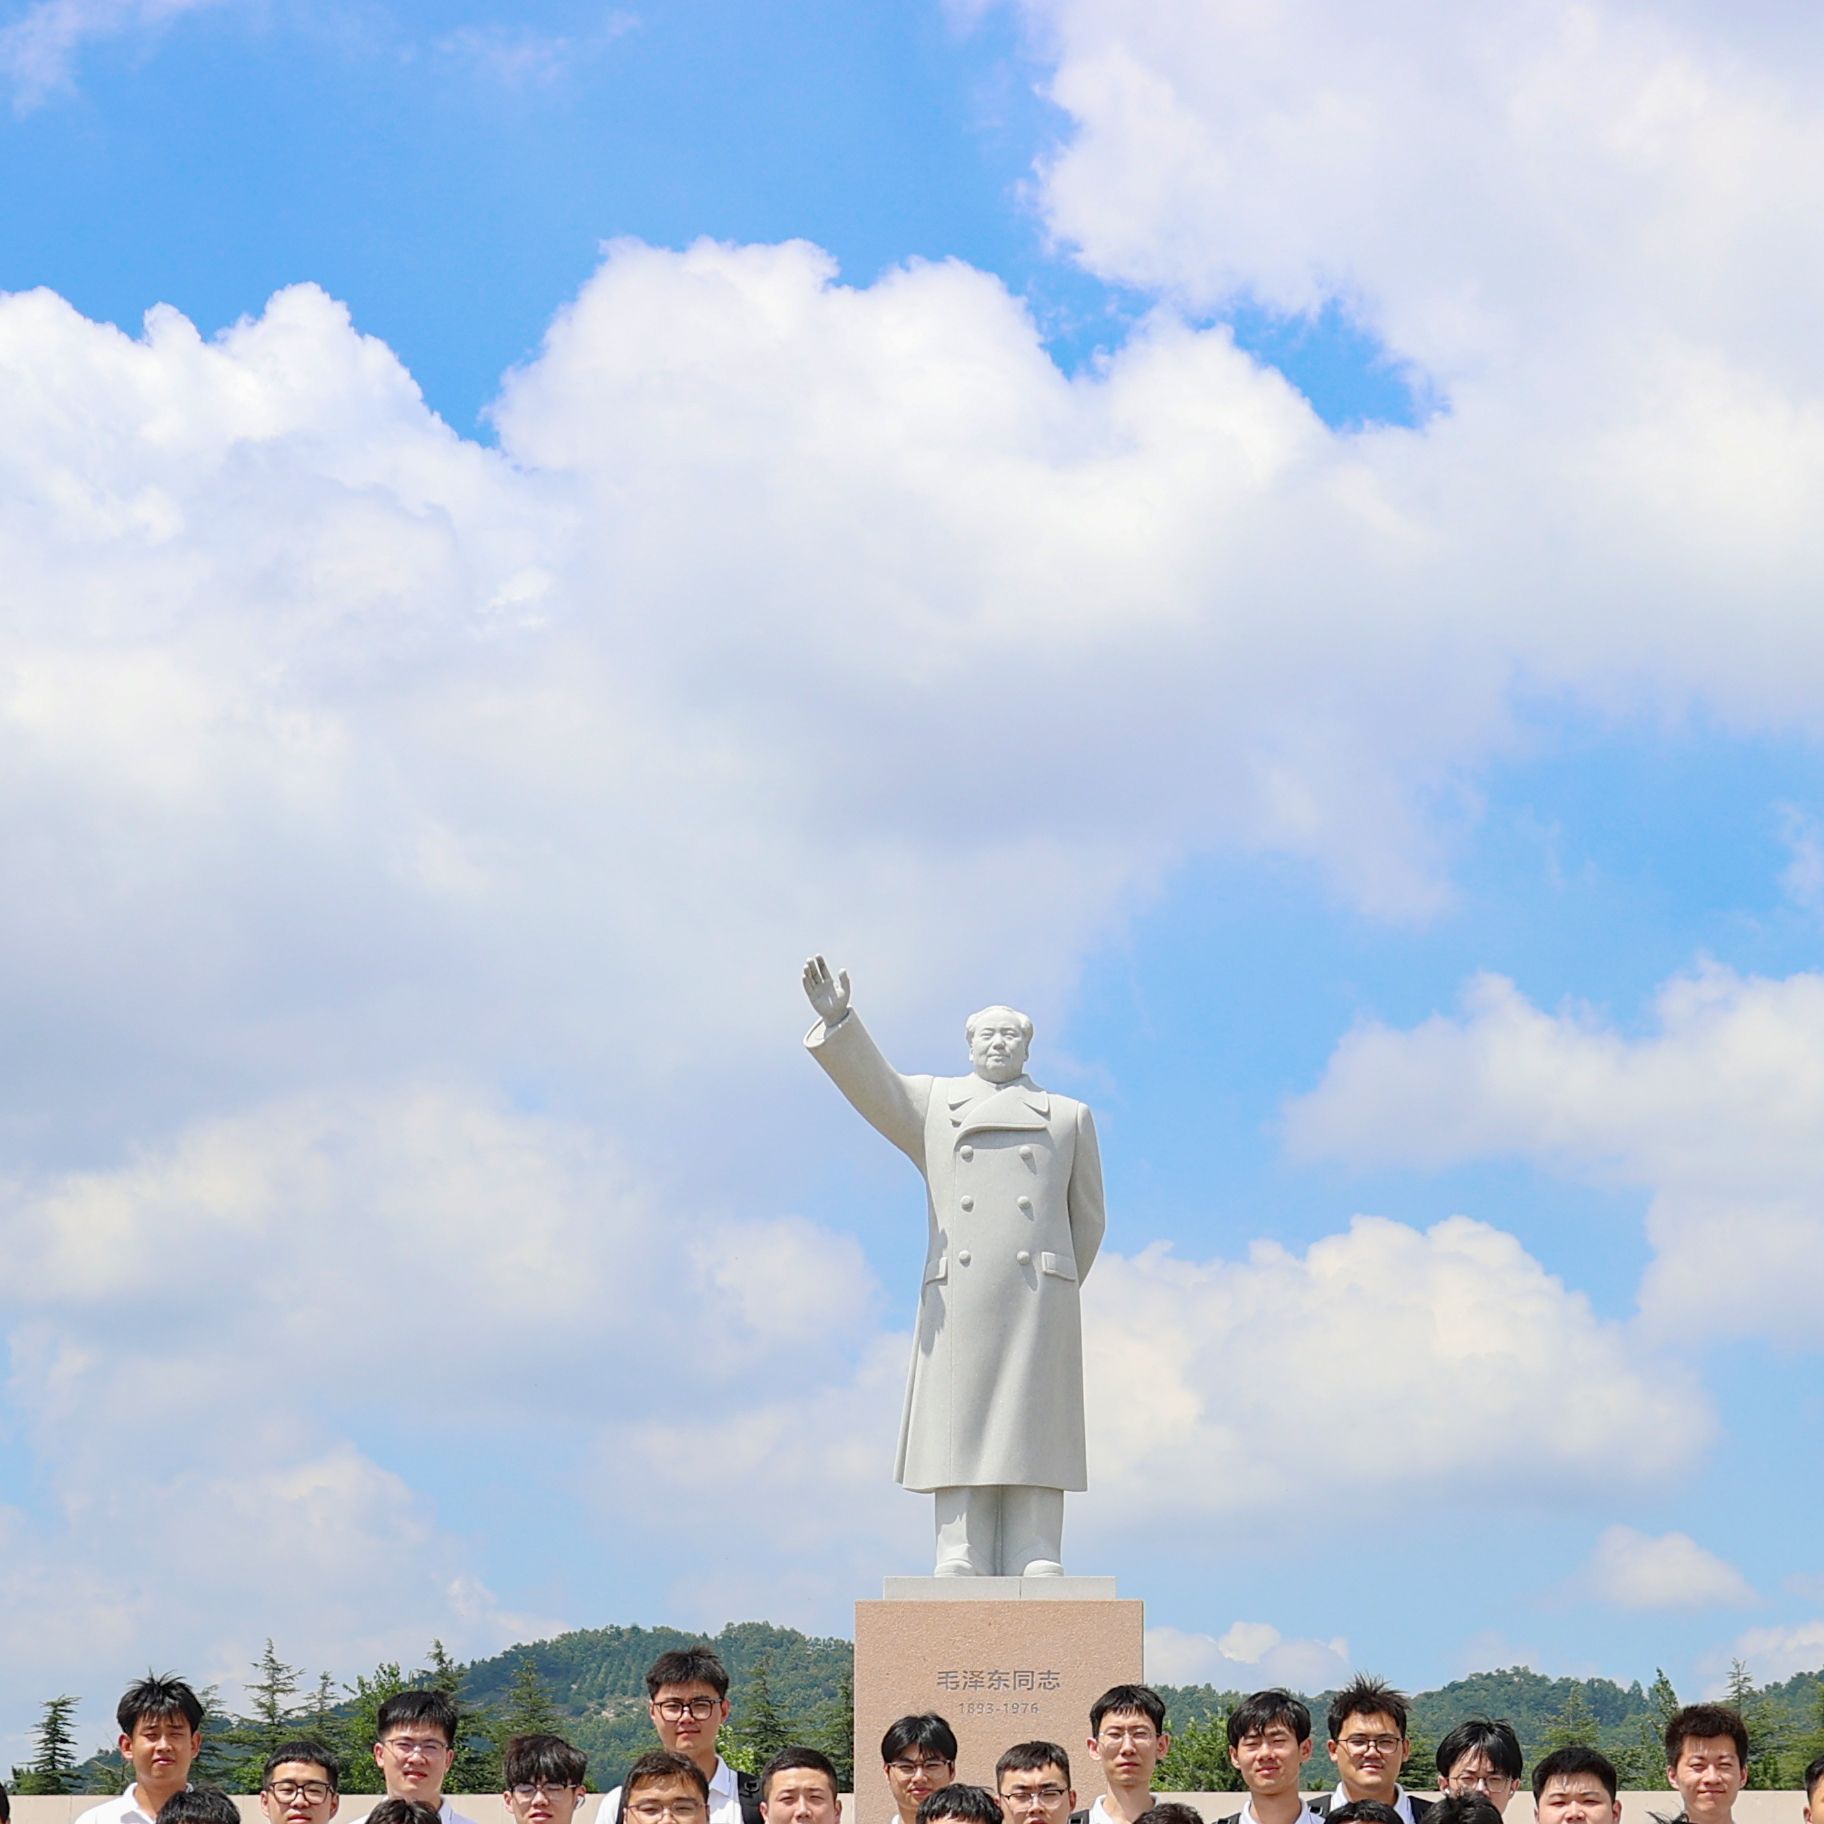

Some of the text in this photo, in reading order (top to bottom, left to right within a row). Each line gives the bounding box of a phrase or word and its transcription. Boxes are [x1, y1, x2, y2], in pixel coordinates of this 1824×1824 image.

[936, 1670, 1061, 1691] 毛泽东同志
[959, 1702, 1040, 1714] 1893-1976
